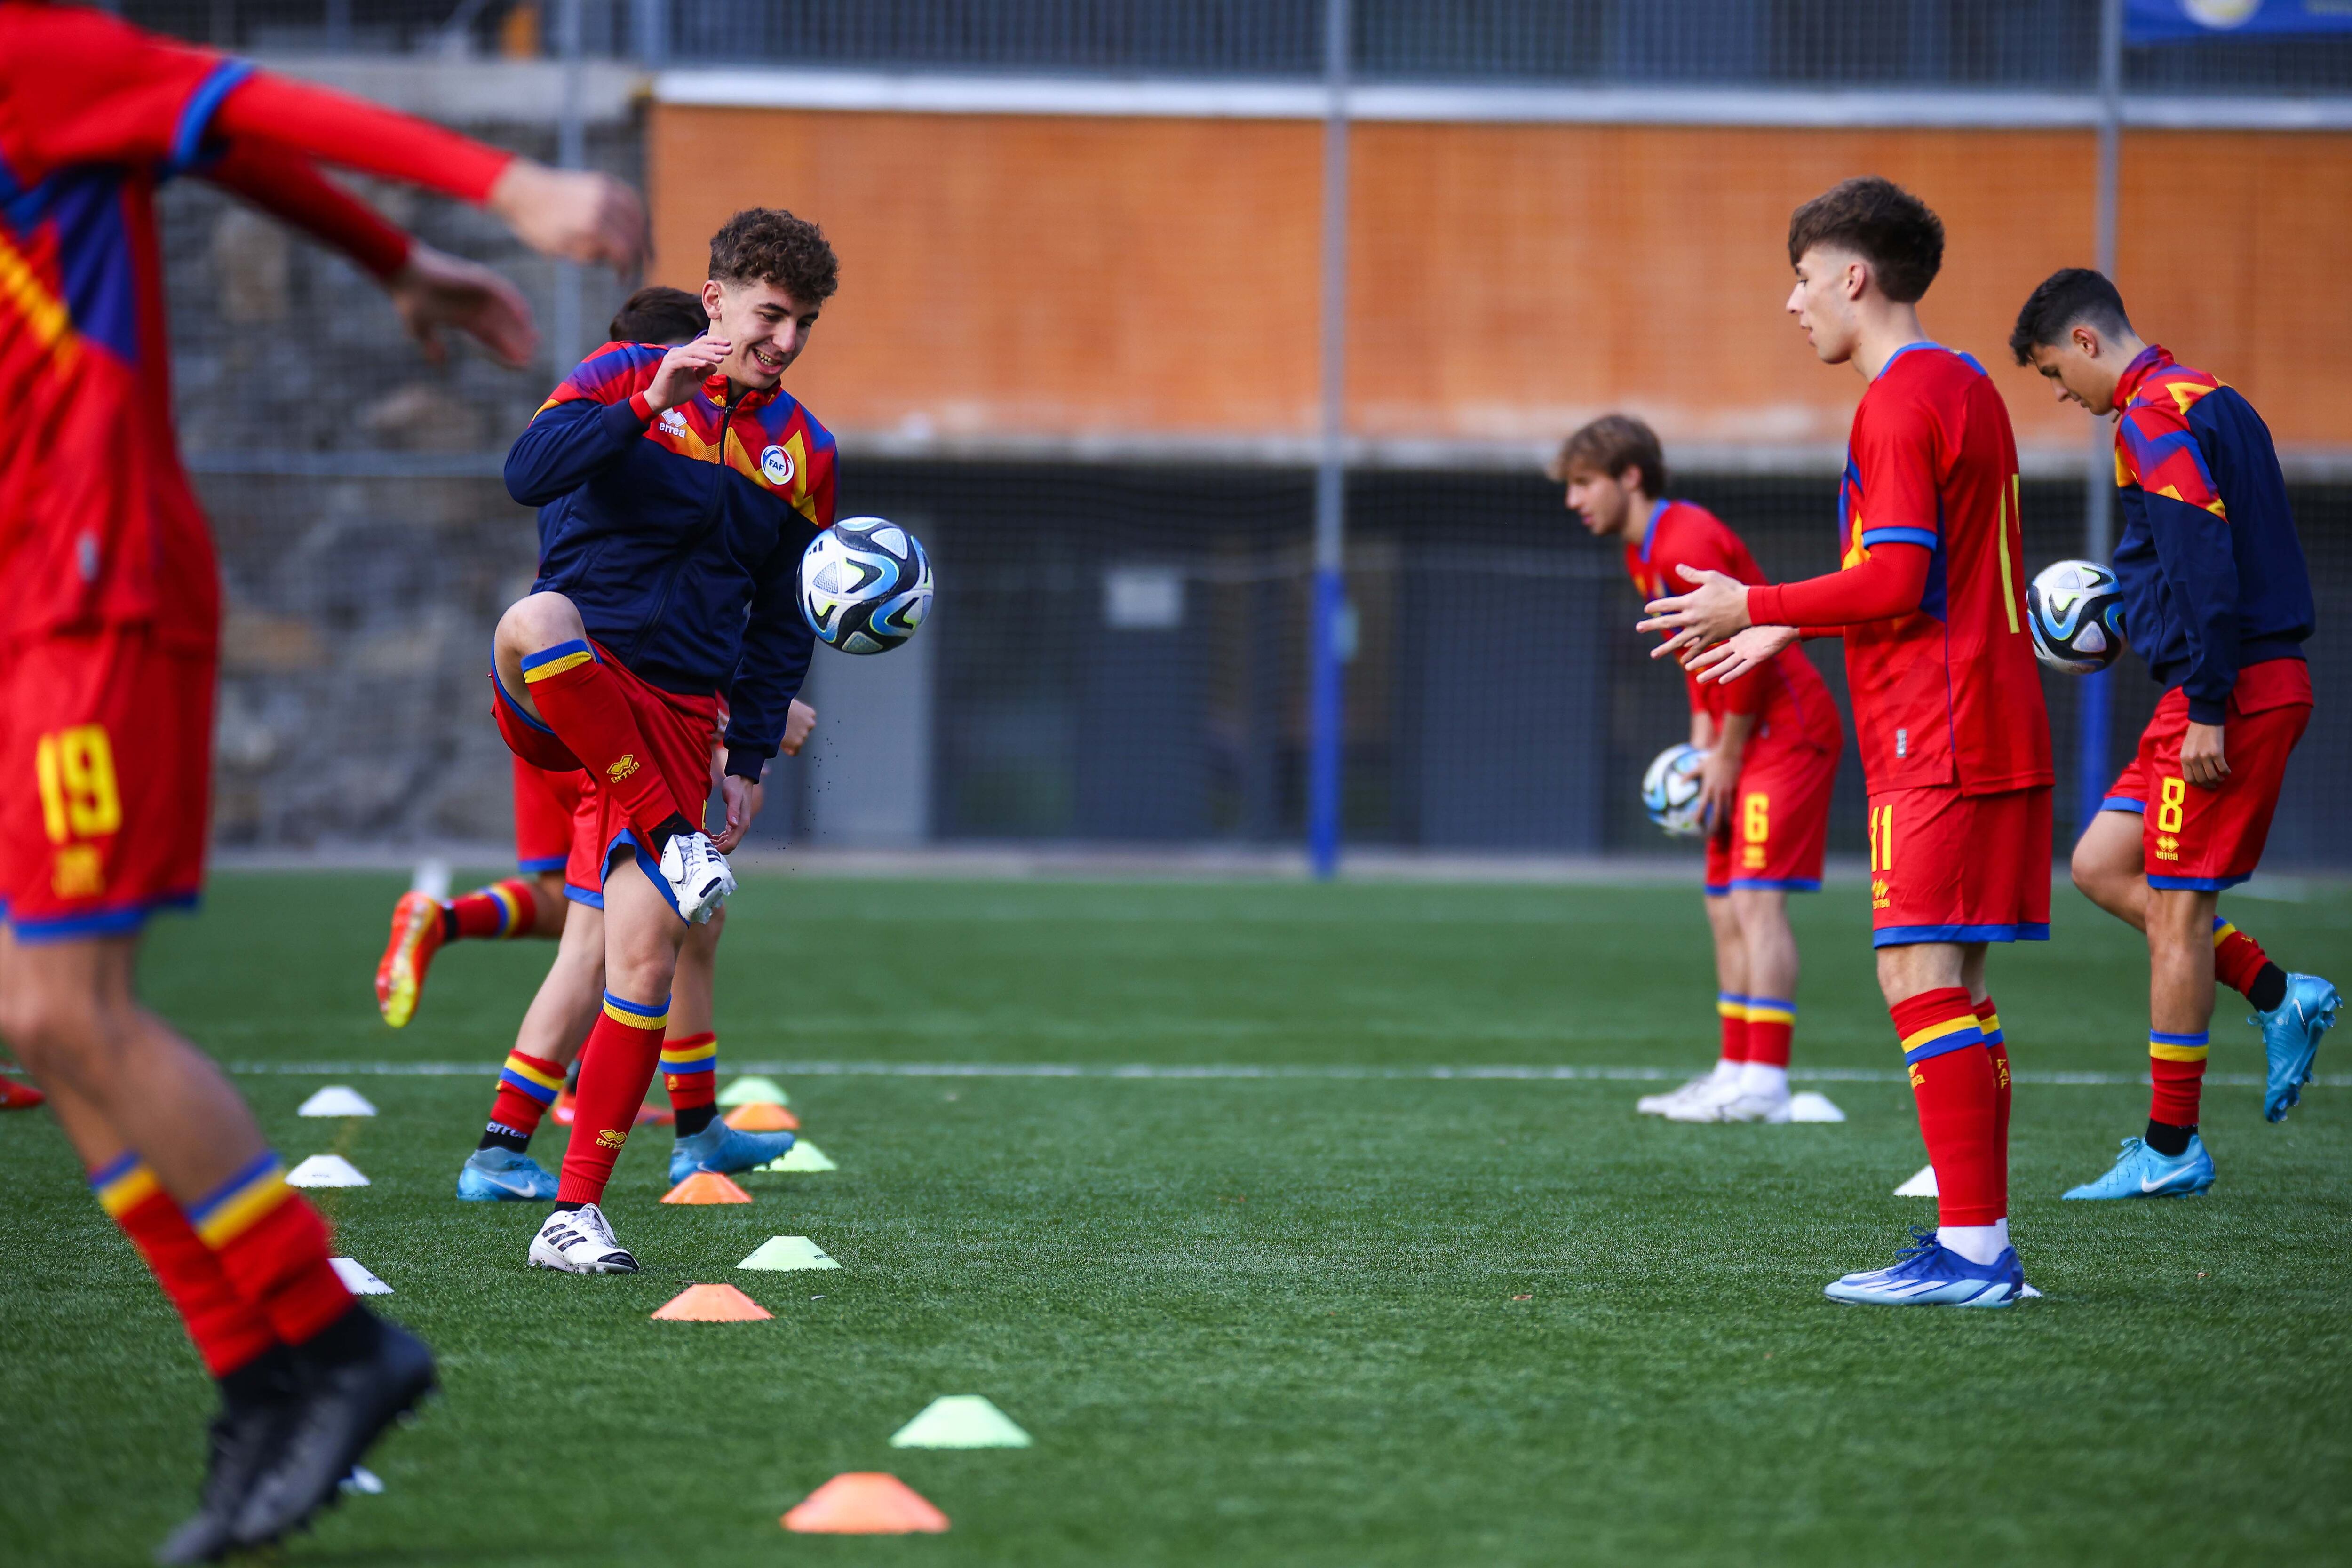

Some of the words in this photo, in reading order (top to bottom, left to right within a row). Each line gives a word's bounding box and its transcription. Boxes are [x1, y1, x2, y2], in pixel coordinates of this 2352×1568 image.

[659, 422, 686, 438] errea
[769, 459, 785, 471] FAF
[35, 722, 123, 845] 19
[2158, 777, 2185, 833] 8
[1744, 792, 1769, 843] 6
[1870, 804, 1893, 872] 11
[2156, 850, 2178, 861] errea
